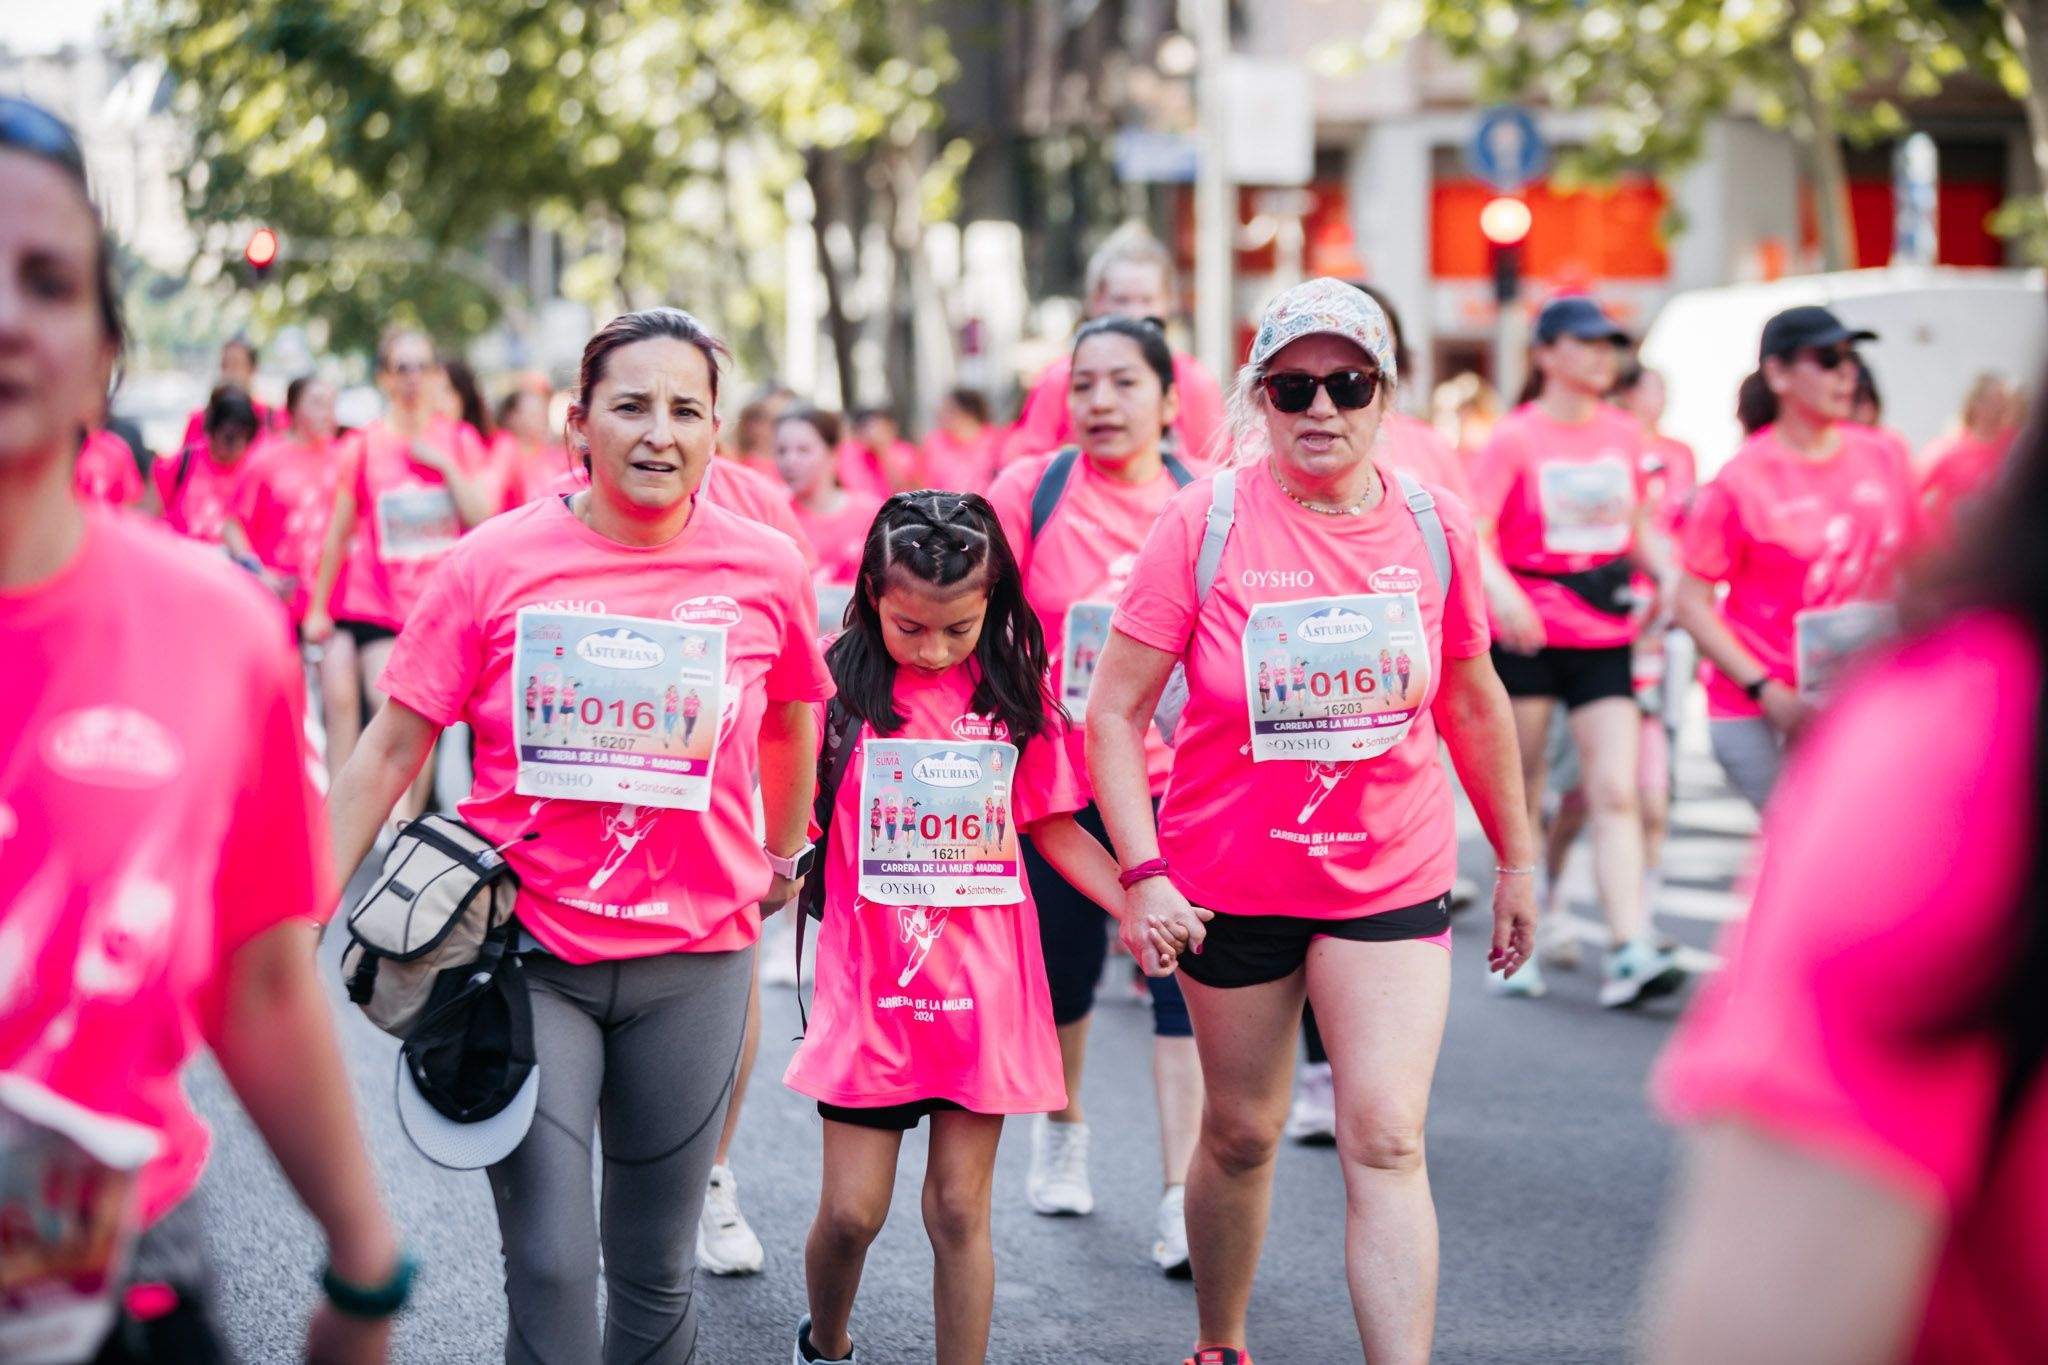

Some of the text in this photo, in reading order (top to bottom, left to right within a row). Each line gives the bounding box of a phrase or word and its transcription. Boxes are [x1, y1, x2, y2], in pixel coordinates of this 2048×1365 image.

[1242, 570, 1315, 588] OYSHO
[535, 600, 606, 617] YSHO
[1303, 622, 1369, 637] ASTURIANA
[583, 641, 659, 661] ASTURIANA
[1310, 667, 1376, 697] 016
[580, 698, 656, 730] 016
[1323, 702, 1363, 716] 16203
[1273, 720, 1315, 732] CARRERA
[1316, 720, 1328, 730] DE
[1330, 719, 1342, 729] LA
[1343, 717, 1373, 728] MUJER
[592, 735, 636, 751] 16207
[1274, 739, 1330, 751] OYSHO
[536, 749, 578, 762] CARRERA
[875, 757, 900, 766] SUMA
[918, 763, 980, 779] ASTURIANA
[536, 770, 593, 788] OYSHO
[920, 814, 981, 840] 016
[1270, 828, 1369, 845] CARRERA DE LA MUJER
[931, 848, 967, 860] 16211
[880, 863, 920, 873] CARRERA
[922, 863, 934, 873] DE
[936, 863, 947, 873] LA
[880, 883, 935, 895] OYSHO
[967, 885, 1005, 896] Santander
[915, 999, 928, 1010] DE
[929, 1000, 941, 1011] LA
[942, 998, 974, 1011] MUJER
[913, 1010, 935, 1023] 2024
